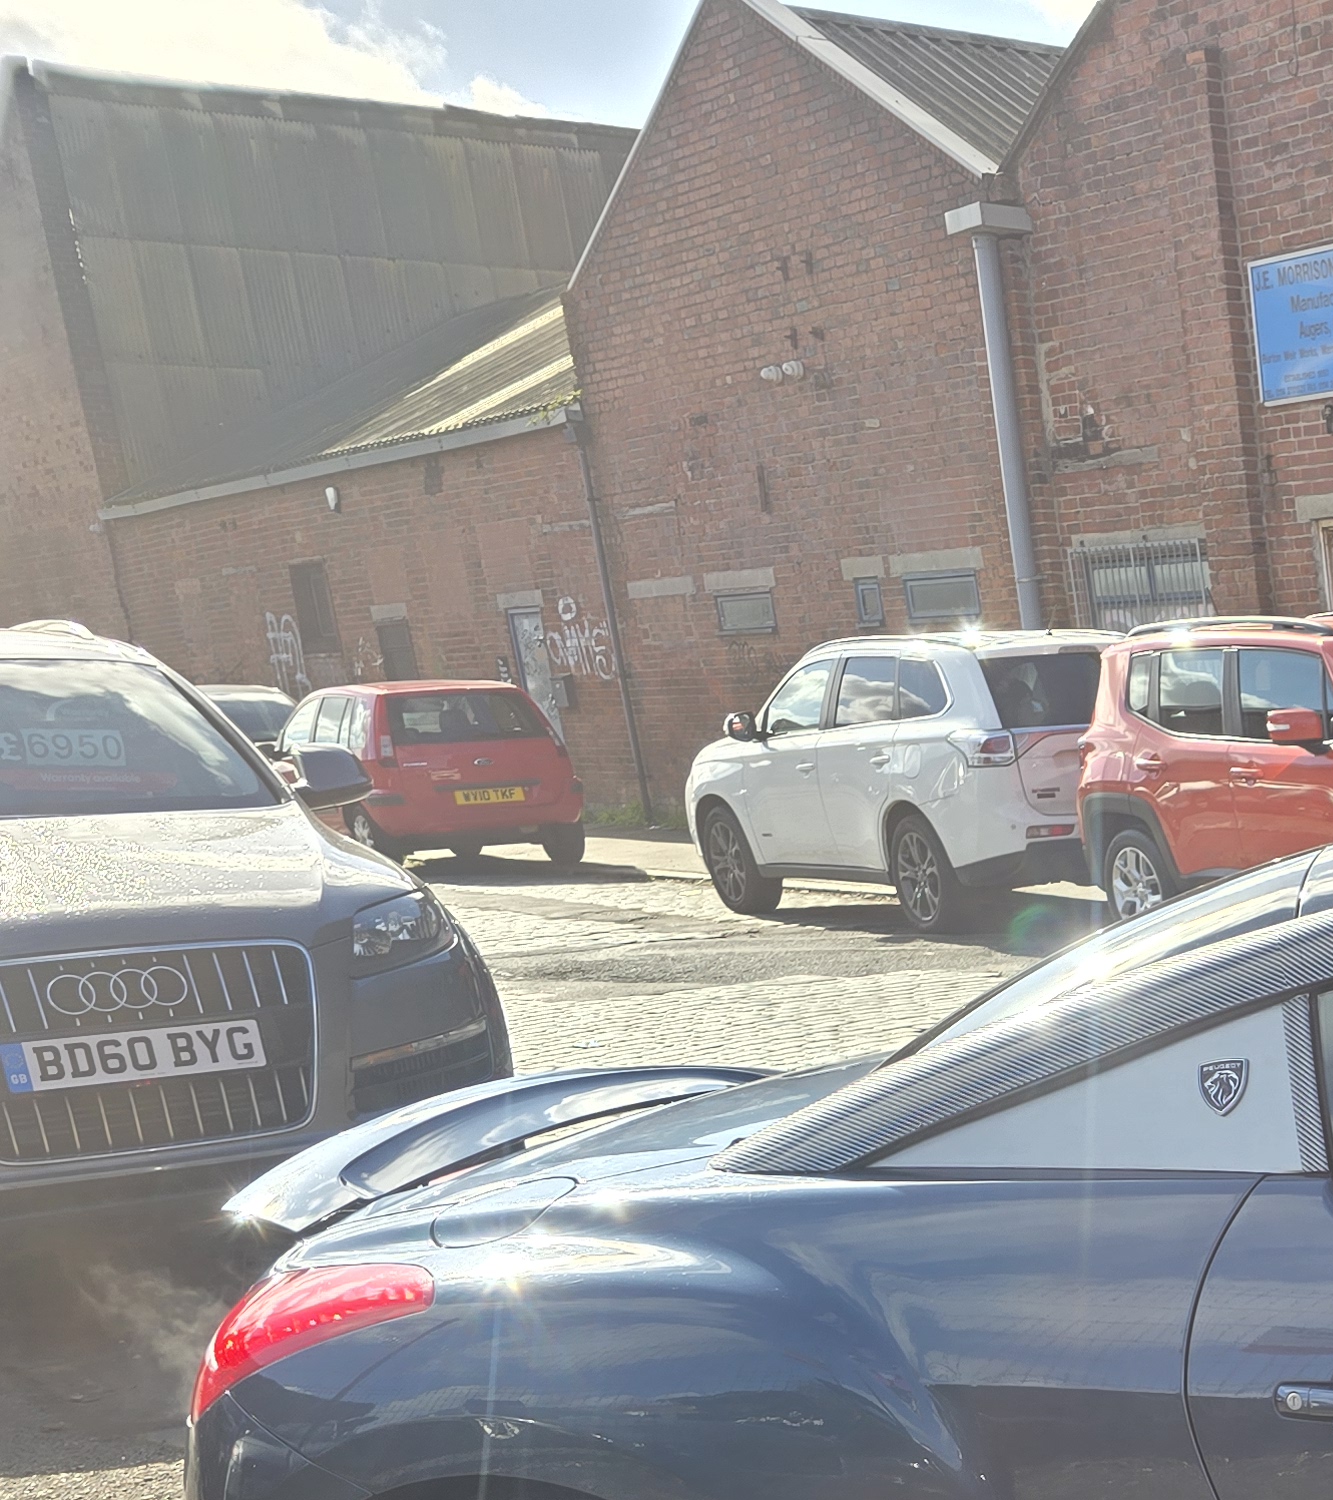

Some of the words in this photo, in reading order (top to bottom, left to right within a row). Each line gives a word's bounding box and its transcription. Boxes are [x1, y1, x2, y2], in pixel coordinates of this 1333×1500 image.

[40, 772, 91, 784] Warranty
[92, 772, 142, 784] available
[493, 787, 516, 801] TKF
[32, 1036, 158, 1082] BD60
[166, 1026, 256, 1068] BYG
[1203, 1062, 1241, 1072] PEUGEOT
[10, 1073, 28, 1084] GB
